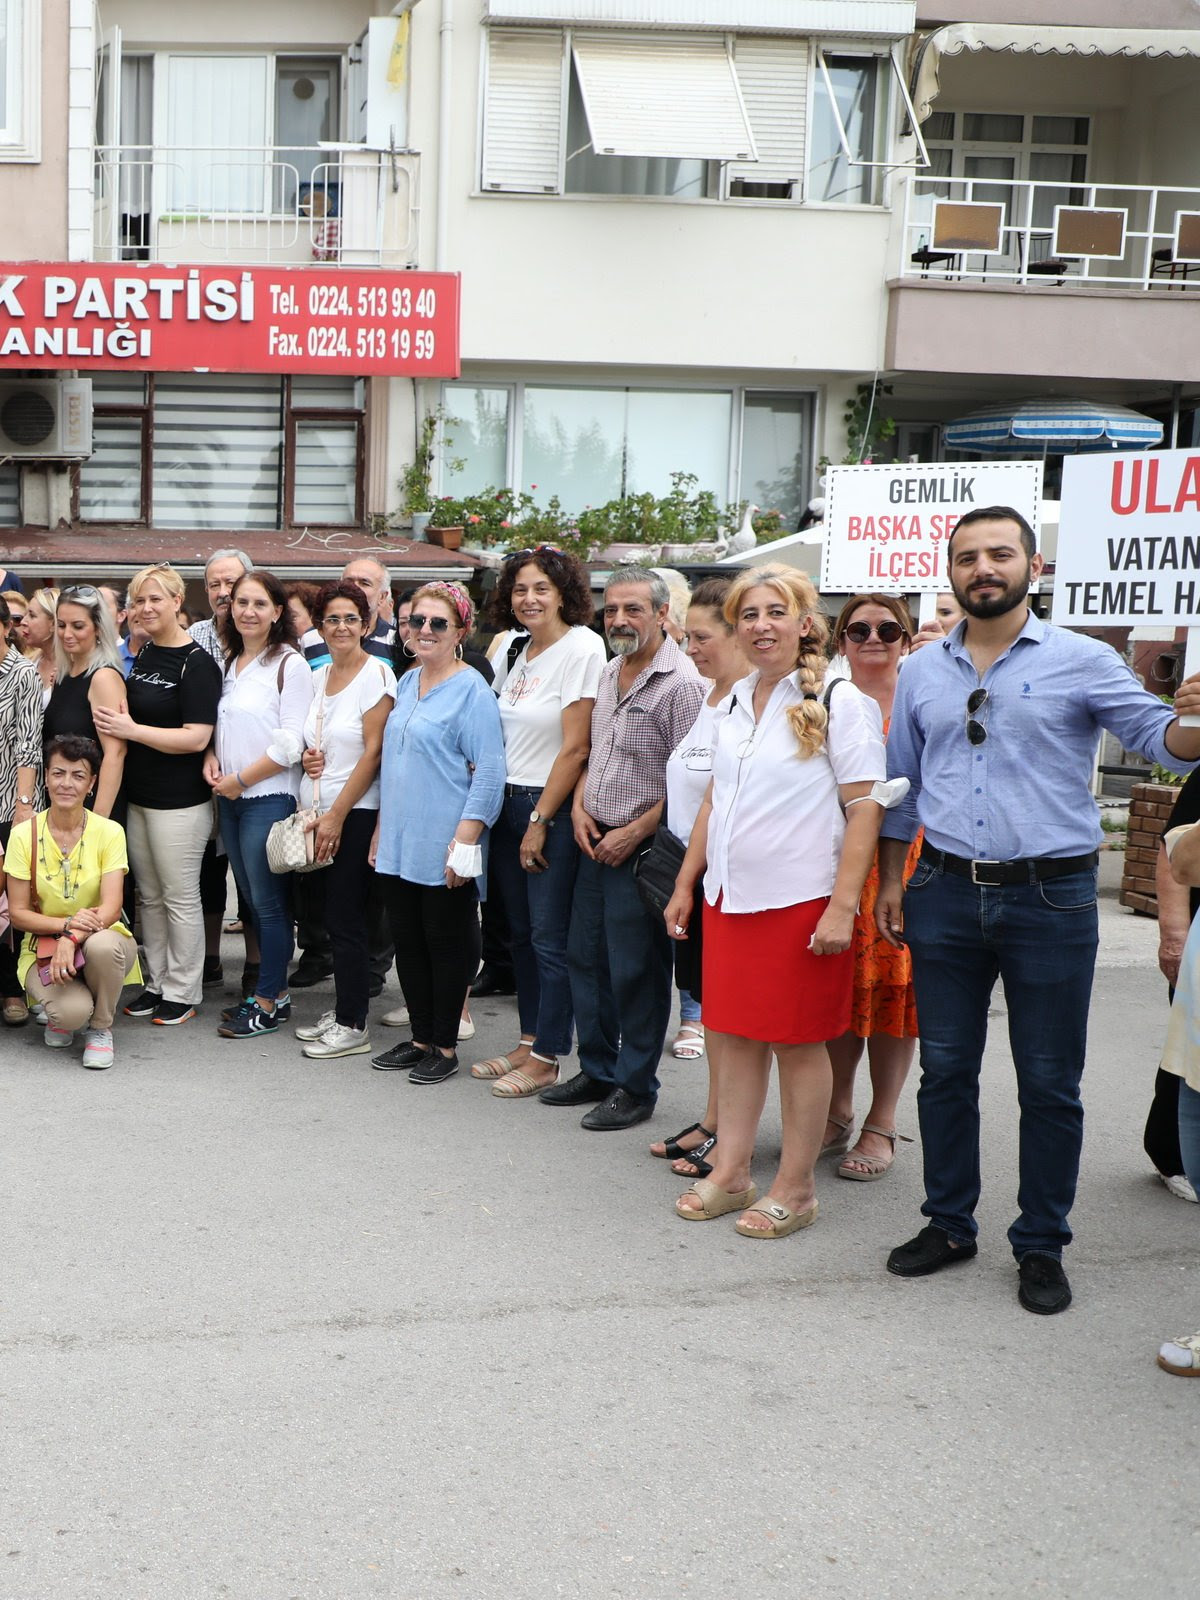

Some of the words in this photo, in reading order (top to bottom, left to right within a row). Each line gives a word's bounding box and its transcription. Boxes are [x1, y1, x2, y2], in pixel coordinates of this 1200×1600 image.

[44, 269, 254, 321] PARTİSİ
[269, 284, 299, 315] Tel.
[309, 285, 353, 316] 0224.
[358, 287, 388, 317] 513
[391, 288, 412, 318] 93
[415, 288, 436, 319] 40
[268, 326, 303, 356] Fax.
[307, 327, 352, 357] 0224.
[356, 328, 386, 358] 513
[391, 329, 411, 359] 19
[414, 330, 435, 359] 59
[889, 472, 976, 504] GEMLİK
[1110, 456, 1200, 515] ULA
[847, 515, 922, 545] BAŞKA
[929, 514, 967, 545] ŞE
[868, 546, 939, 582] İLÇESİ
[1107, 536, 1200, 571] VATAN
[1065, 581, 1163, 614] TEMEL
[1174, 581, 1200, 614] H
